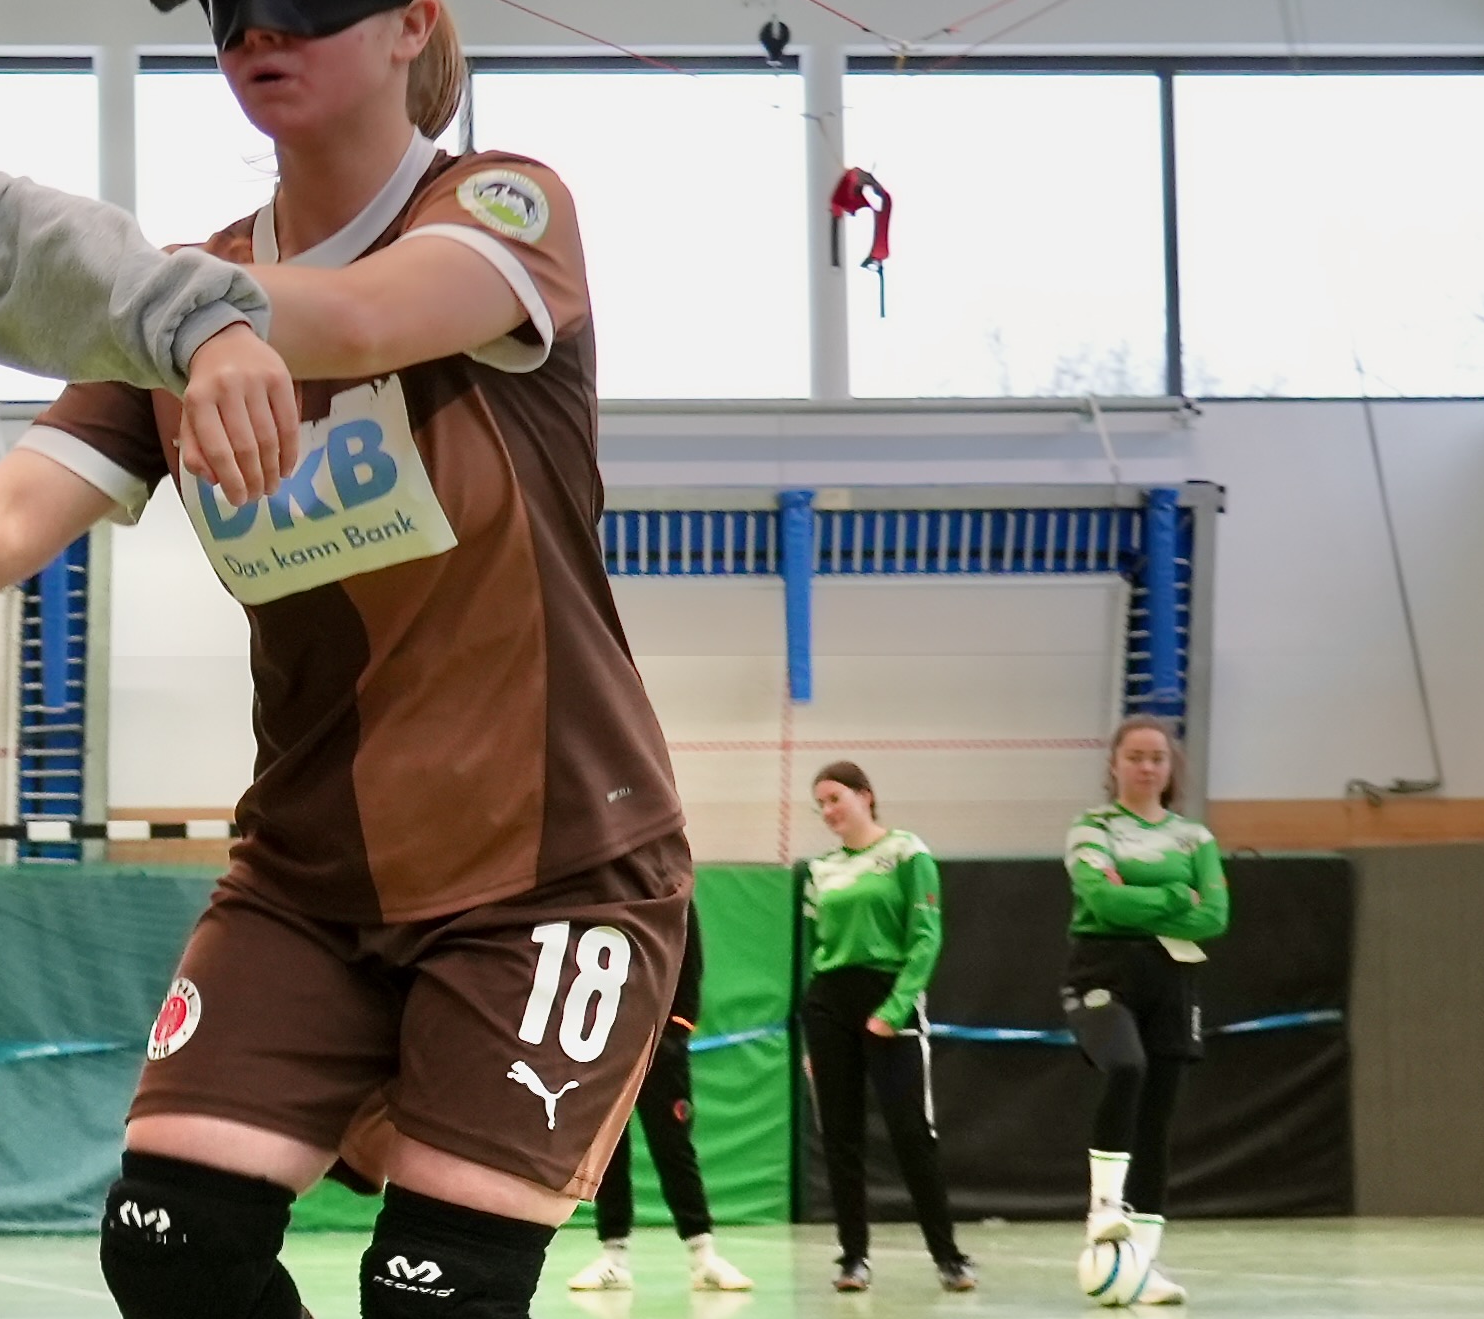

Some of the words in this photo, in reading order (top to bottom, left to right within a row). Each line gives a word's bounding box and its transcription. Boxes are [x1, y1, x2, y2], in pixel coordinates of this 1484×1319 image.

[197, 418, 398, 542] DKB
[223, 551, 270, 579] Das
[270, 540, 341, 569] kann
[341, 508, 418, 551] Bank
[517, 919, 632, 1064] 18
